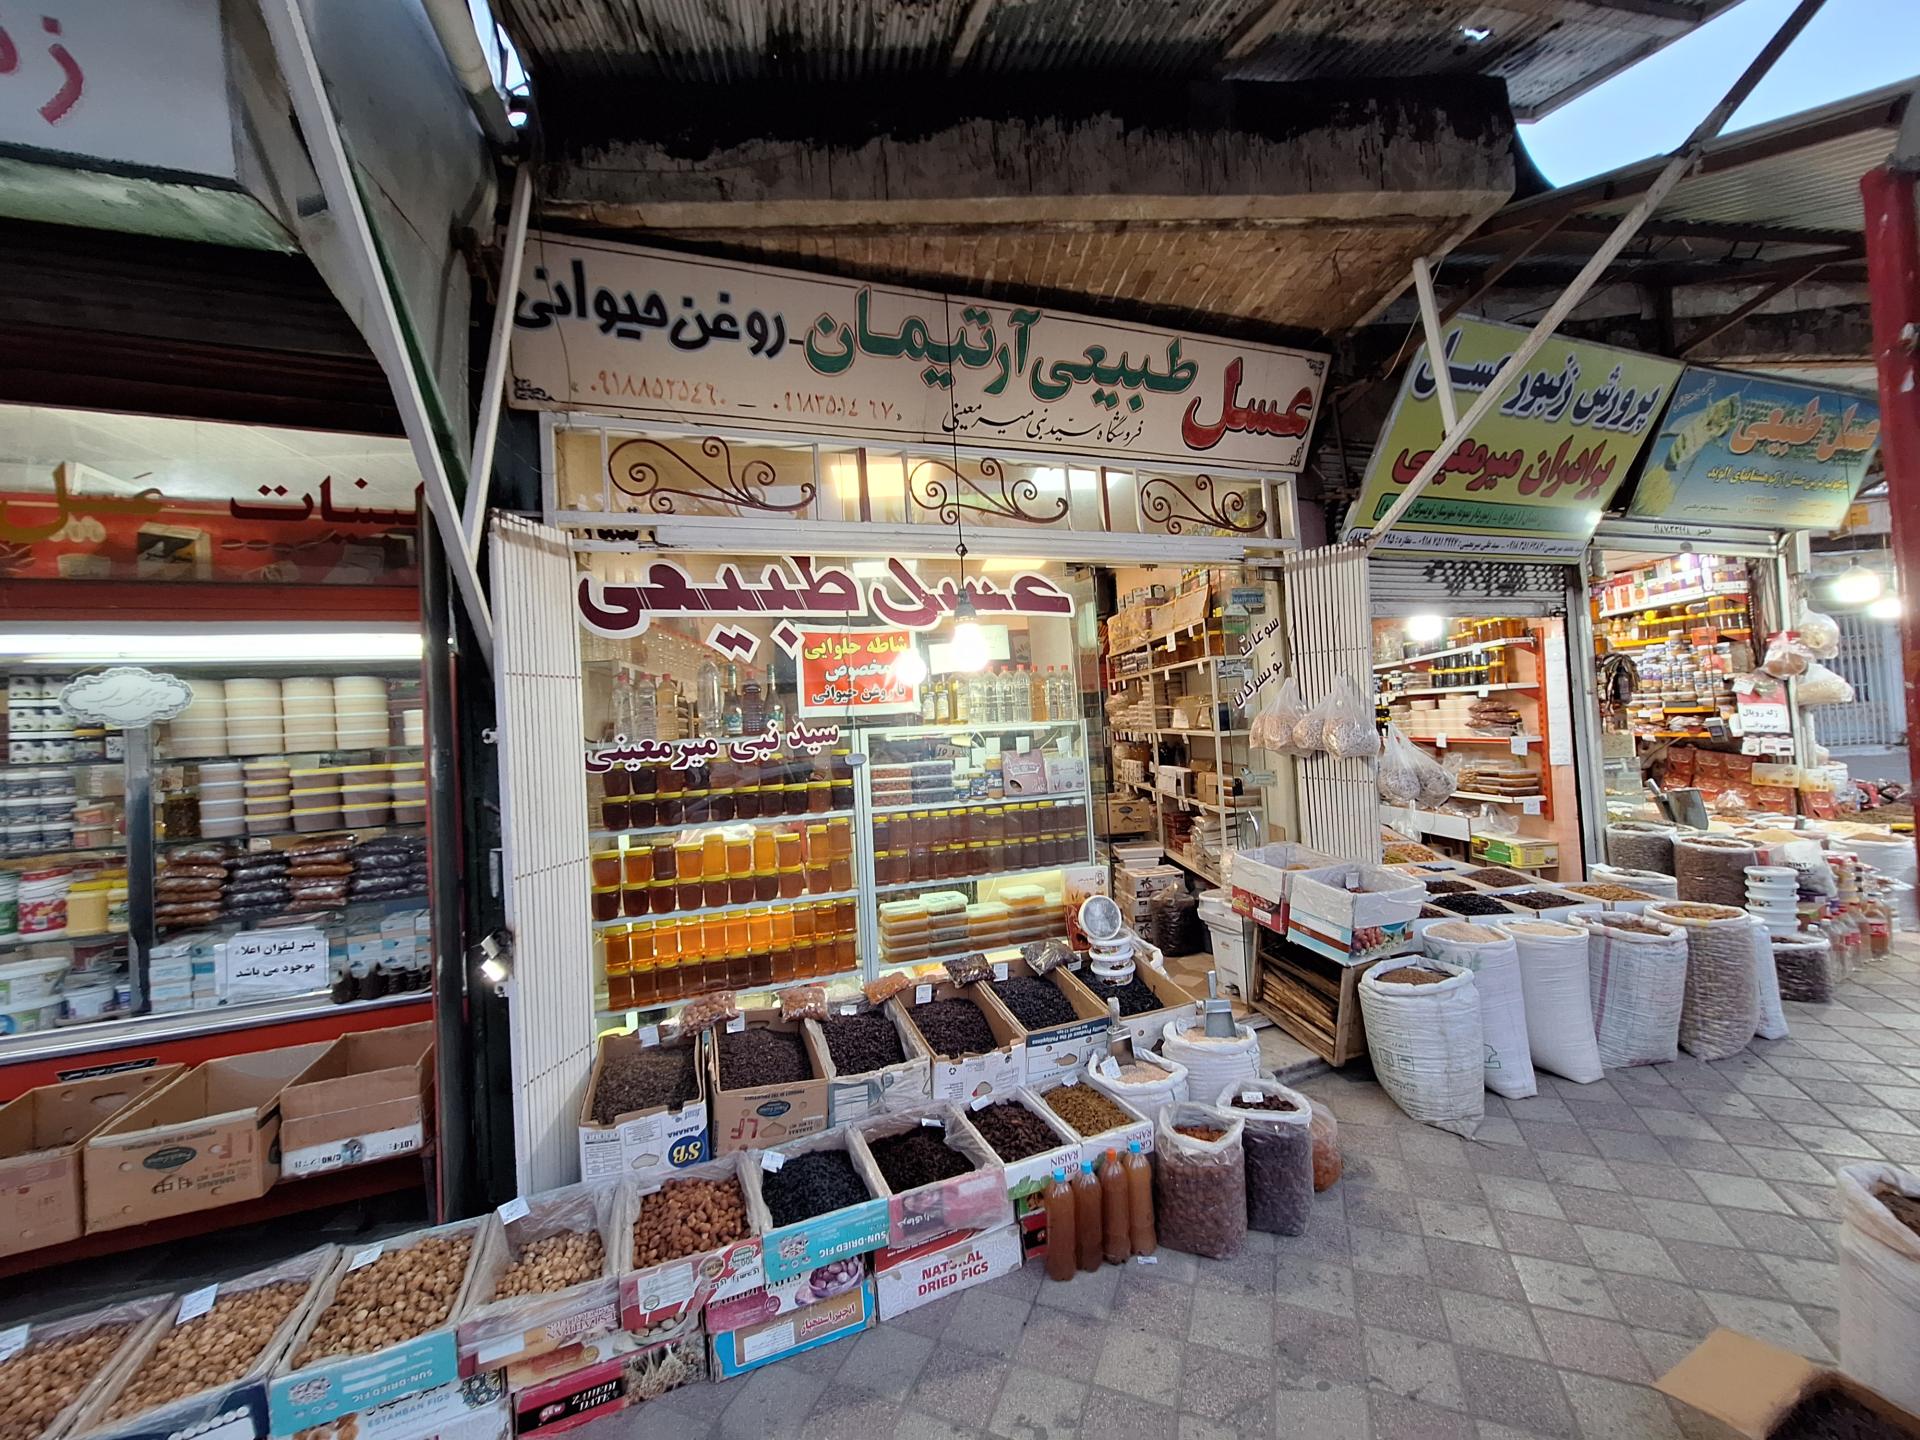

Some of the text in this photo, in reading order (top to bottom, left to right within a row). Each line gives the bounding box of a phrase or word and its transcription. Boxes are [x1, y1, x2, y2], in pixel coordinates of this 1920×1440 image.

[514, 259, 1314, 451] عسل طبیعی آرتیمان روغن حیوانی
[1501, 352, 1581, 424] زنبور
[1573, 363, 1663, 435] پرورش
[1025, 408, 1048, 439] نبی
[1097, 412, 1143, 446] فروشگاه
[1729, 396, 1880, 463] عسل طبیعی
[1392, 430, 1617, 499] برادران میرمعیی
[577, 554, 1076, 663] عسل طبیعی
[804, 637, 862, 660] حلوایی
[1239, 616, 1280, 658] سوغات
[1234, 650, 1285, 709] تویسرکان
[731, 721, 780, 765] نبی
[788, 720, 839, 751] سید
[300, 940, 316, 952] پنیر
[236, 963, 315, 977] موجود می باشد
[667, 1124, 700, 1139] BANANA
[671, 1141, 704, 1164] SB
[1049, 1150, 1079, 1167] RAISIN
[835, 1230, 887, 1253] SUN-DRIED
[917, 1261, 989, 1297] DRIED FIGS
[921, 1250, 983, 1280] NATAL
[571, 1381, 617, 1405] ZAHEDI
[579, 1393, 610, 1412] DATE
